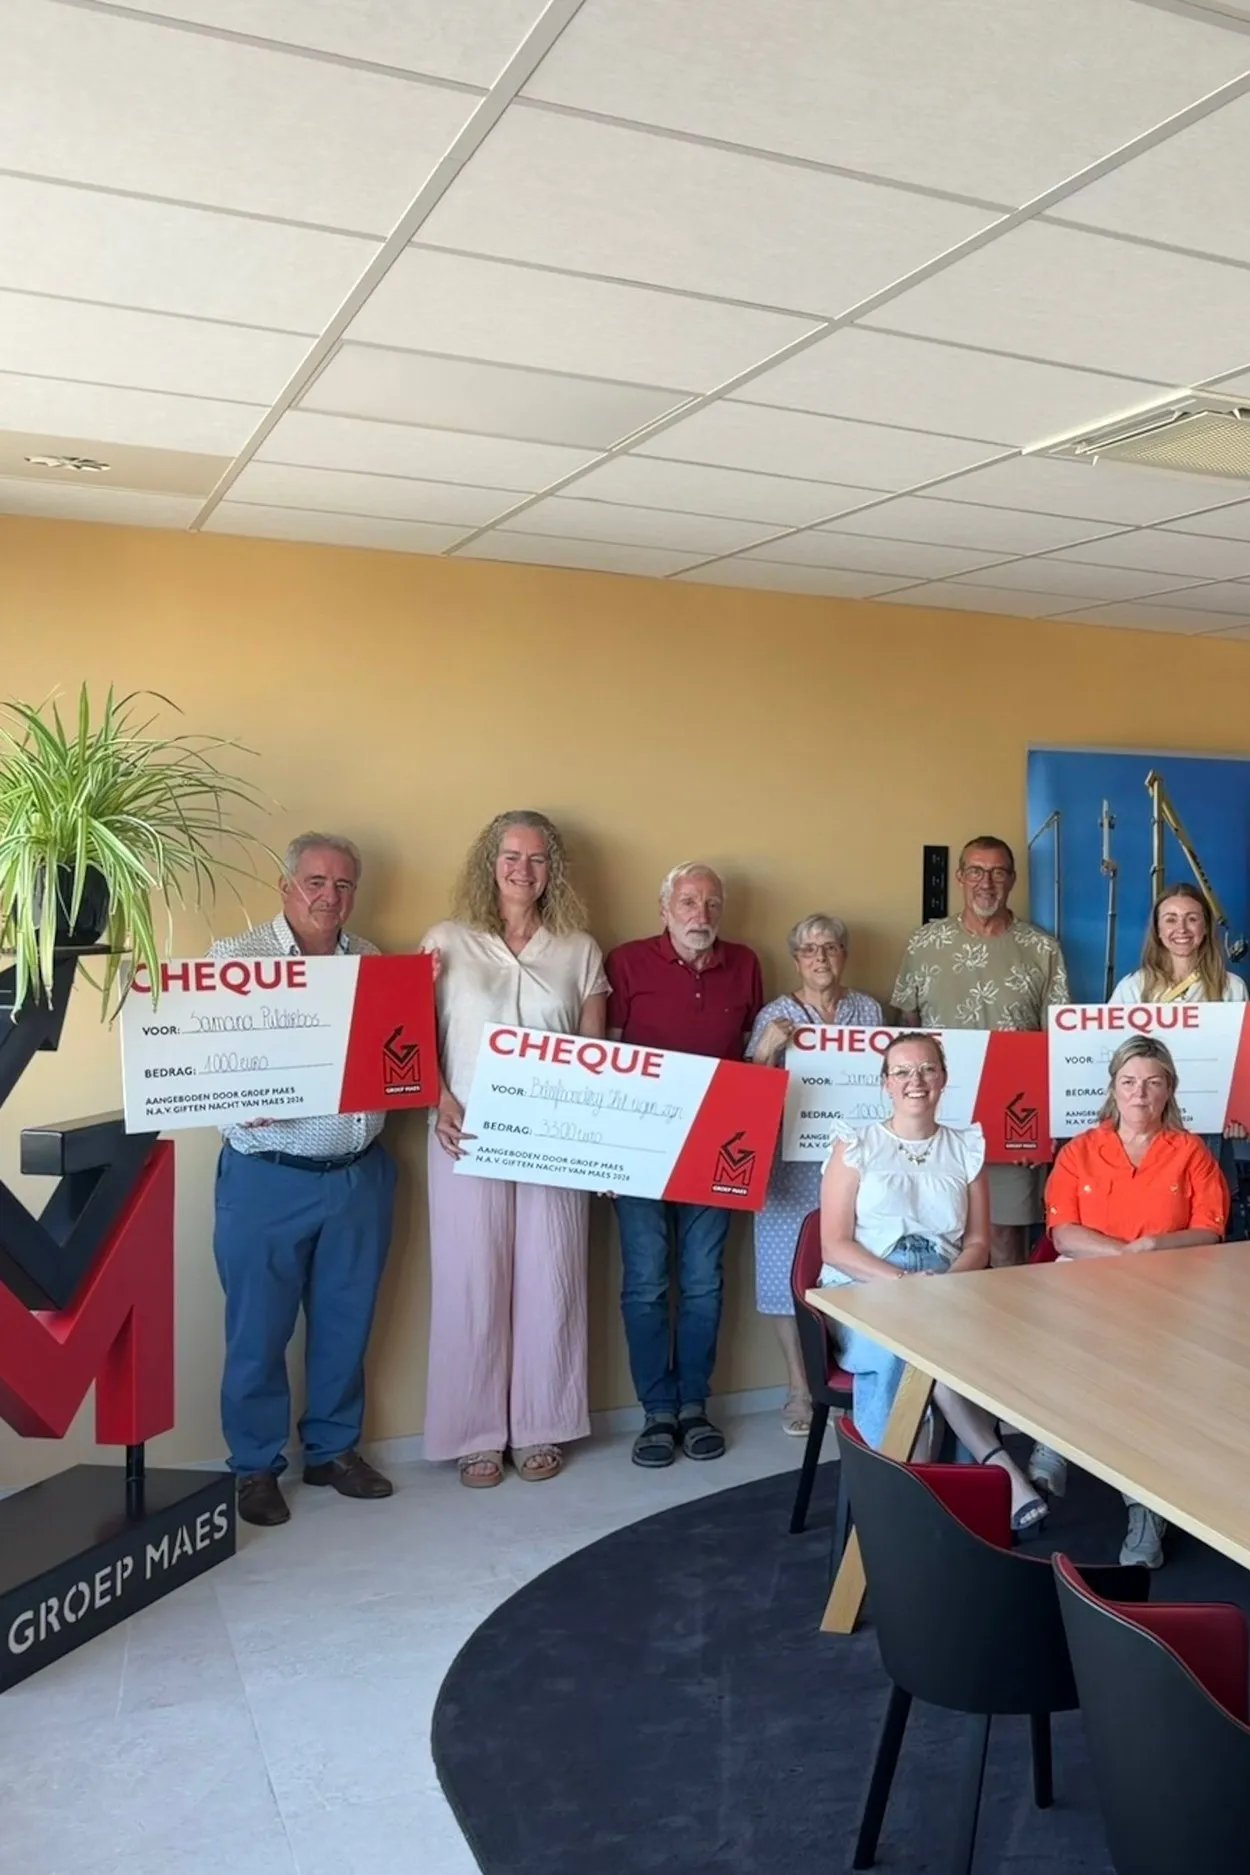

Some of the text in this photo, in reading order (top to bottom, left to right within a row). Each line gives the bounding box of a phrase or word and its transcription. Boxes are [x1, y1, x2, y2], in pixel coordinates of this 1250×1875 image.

[1055, 1006, 1198, 1033] CHEQUE
[489, 1029, 663, 1078] CHEQUE
[8, 1502, 228, 1654] GROEP MAES
